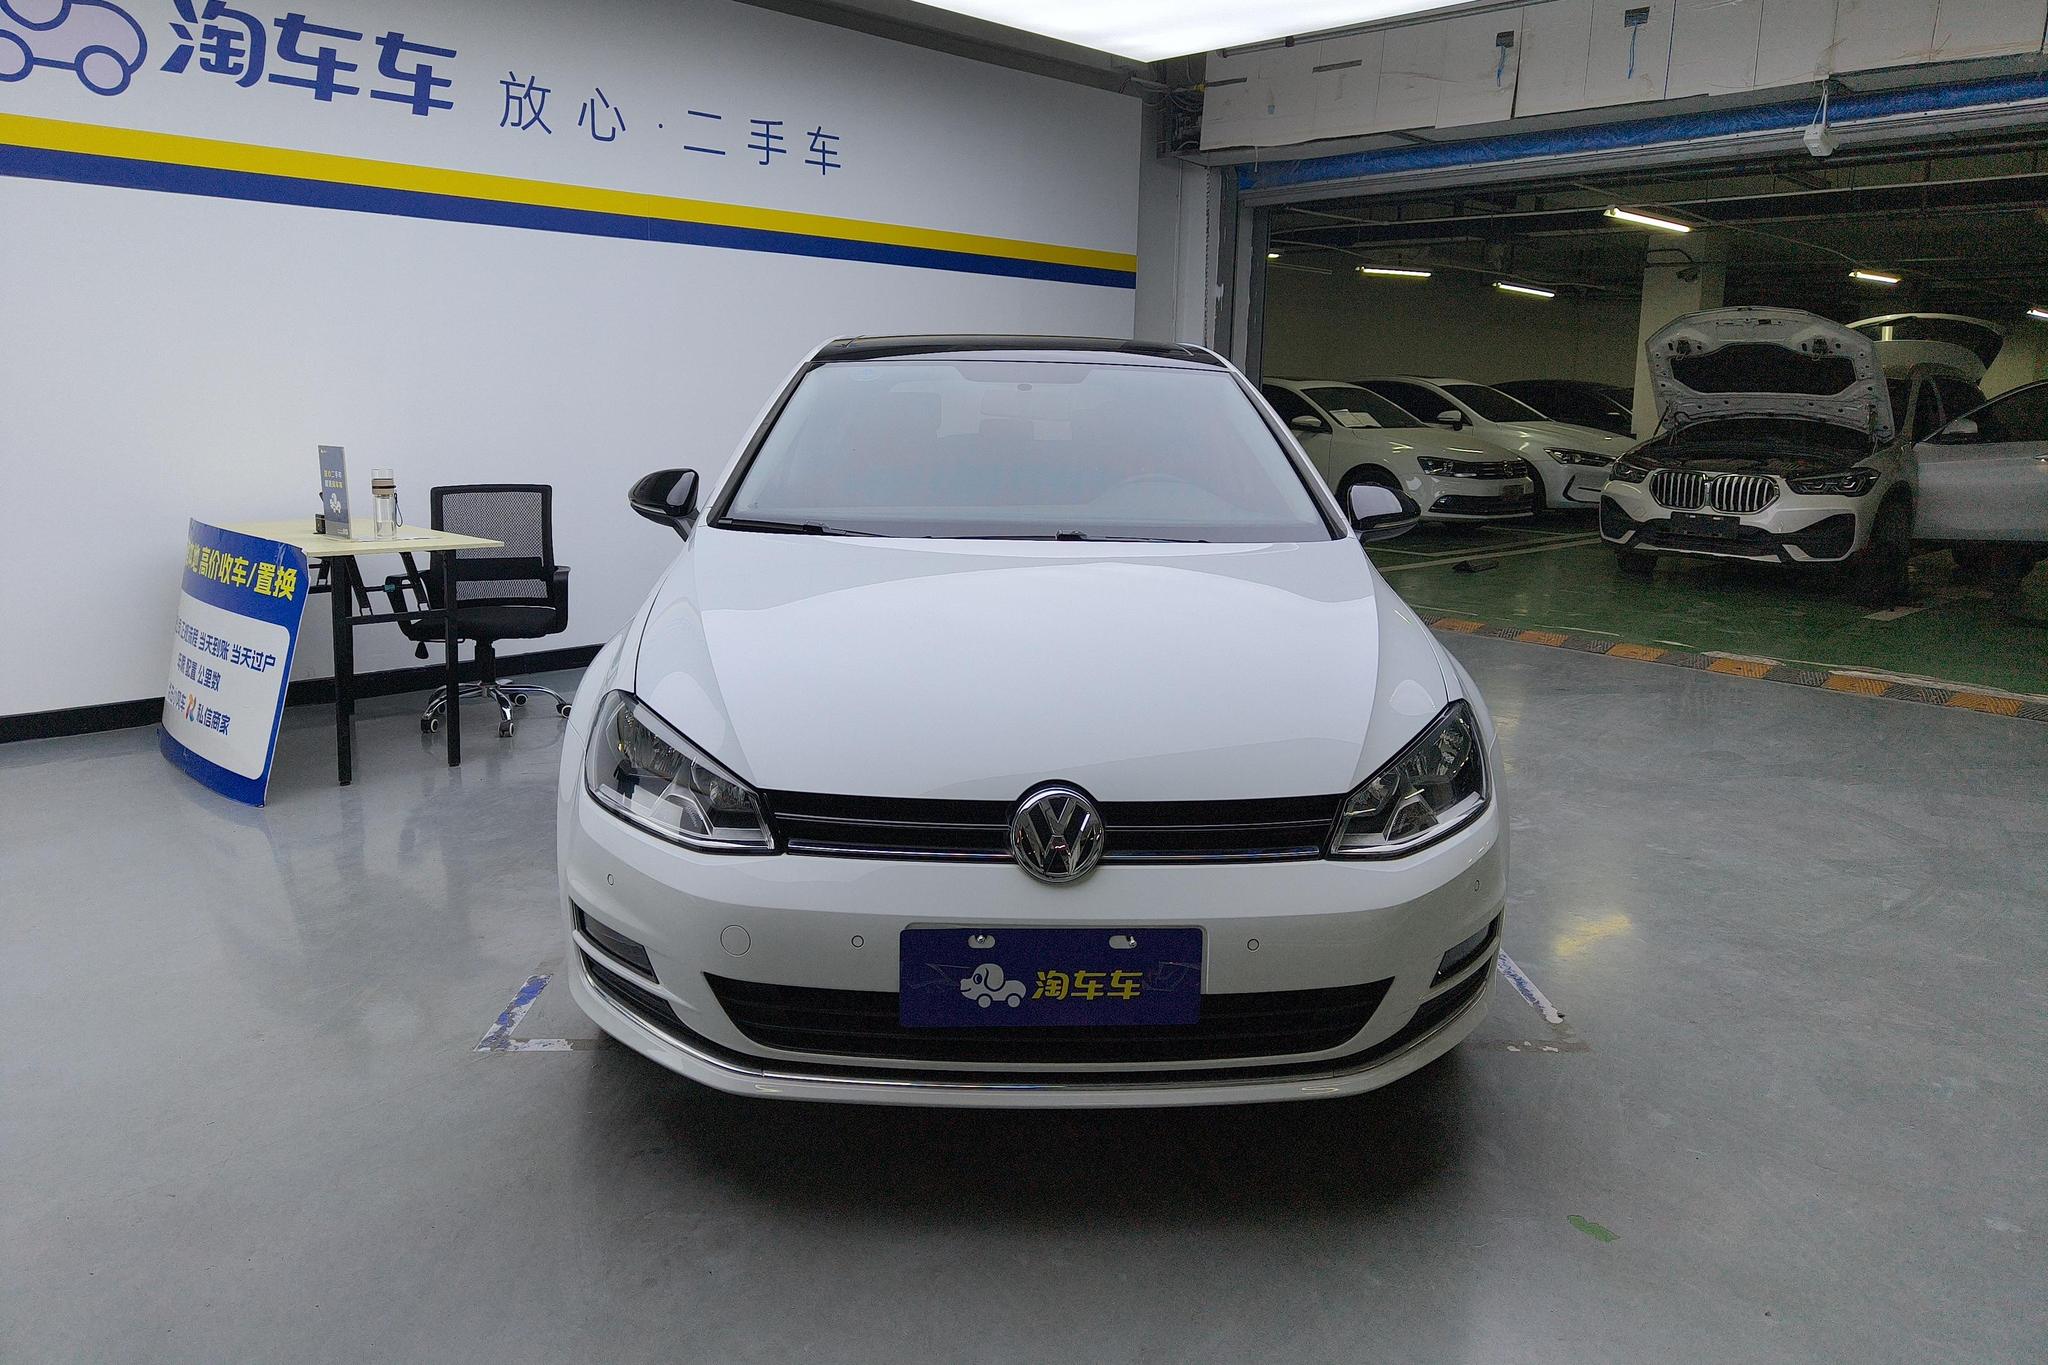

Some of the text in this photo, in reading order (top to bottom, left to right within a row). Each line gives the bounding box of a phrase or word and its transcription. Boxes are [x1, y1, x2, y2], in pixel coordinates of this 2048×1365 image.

[160, 0, 457, 116] 淘车车
[198, 632, 230, 661] 当天到账
[230, 643, 276, 673] 当天过户
[197, 664, 221, 692] 公里数
[196, 703, 231, 736] 私信商家
[1031, 969, 1143, 1000] 淘车车
